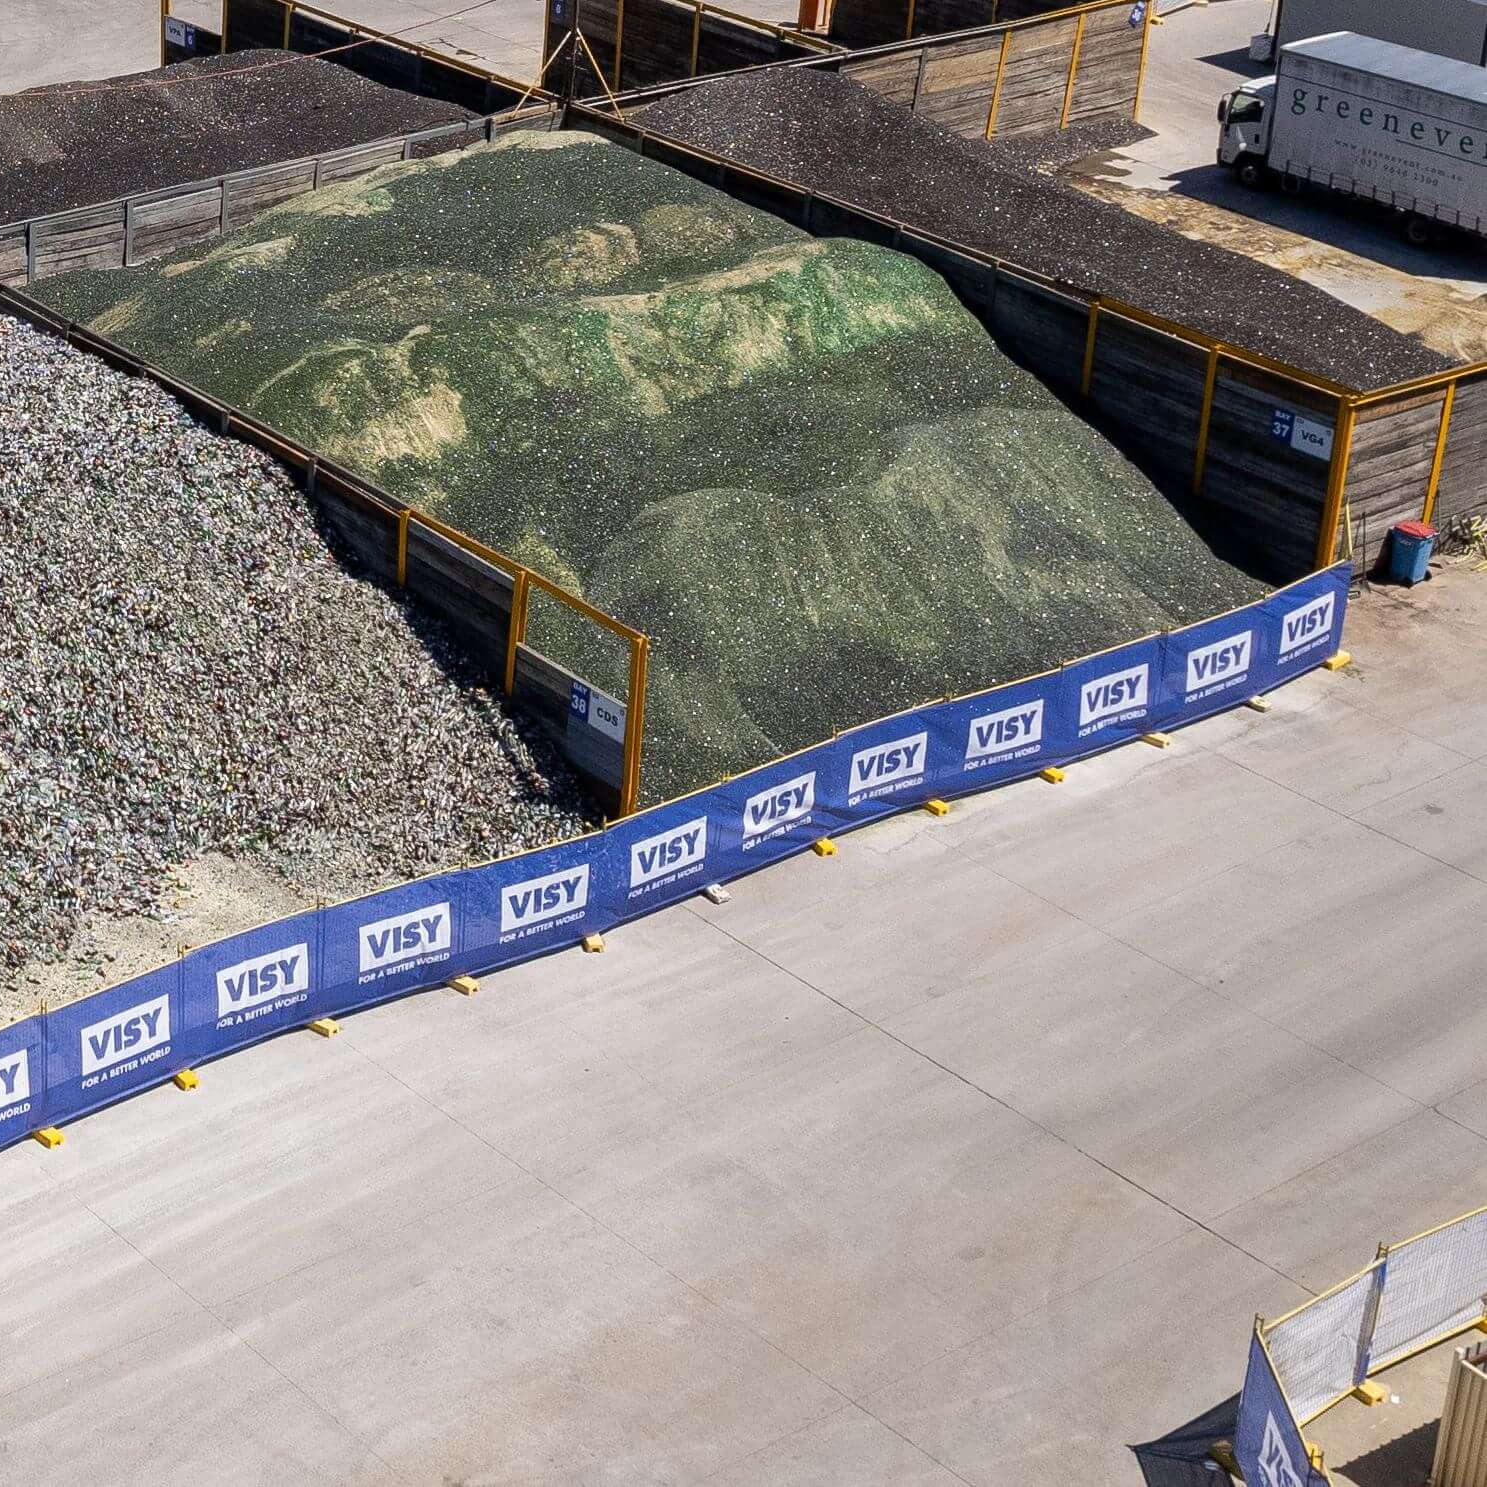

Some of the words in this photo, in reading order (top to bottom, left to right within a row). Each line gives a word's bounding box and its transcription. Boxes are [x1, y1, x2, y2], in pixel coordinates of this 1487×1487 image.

[1272, 422, 1290, 437] 37
[1301, 430, 1323, 446] VG4
[1287, 602, 1331, 642] VISY
[1193, 642, 1246, 681] VISY
[571, 695, 586, 713] 38
[597, 707, 618, 726] CDS
[1086, 675, 1142, 713] VISY
[976, 710, 1037, 748] VISY
[857, 743, 920, 781] VISY
[964, 761, 979, 772] FOR
[1015, 745, 1041, 758] WORLD
[895, 777, 923, 792] WORLD
[751, 783, 809, 825] VISY
[637, 827, 701, 874] VISY
[743, 840, 755, 852] FOR
[755, 837, 762, 845] A
[508, 876, 582, 919] VISY
[628, 888, 643, 899] FOR
[643, 885, 650, 893] A
[677, 864, 703, 879] WORLD
[367, 914, 442, 959] VISY
[499, 933, 517, 945] FOR
[518, 929, 525, 938] A
[526, 920, 554, 936] BETTER
[555, 911, 586, 926] WORLD
[224, 955, 299, 1002] VISY
[358, 973, 376, 984] FOR
[378, 969, 385, 978] A
[386, 961, 415, 976] BETTER
[416, 953, 450, 966] WORLD
[236, 1015, 243, 1023] A
[245, 1003, 273, 1021] BETTER
[275, 994, 308, 1010] WORLD
[88, 1007, 162, 1060] VISY
[81, 1076, 99, 1090] FOR
[100, 1072, 107, 1081] A
[110, 1059, 138, 1077] BETTER
[140, 1046, 171, 1066] WORLD
